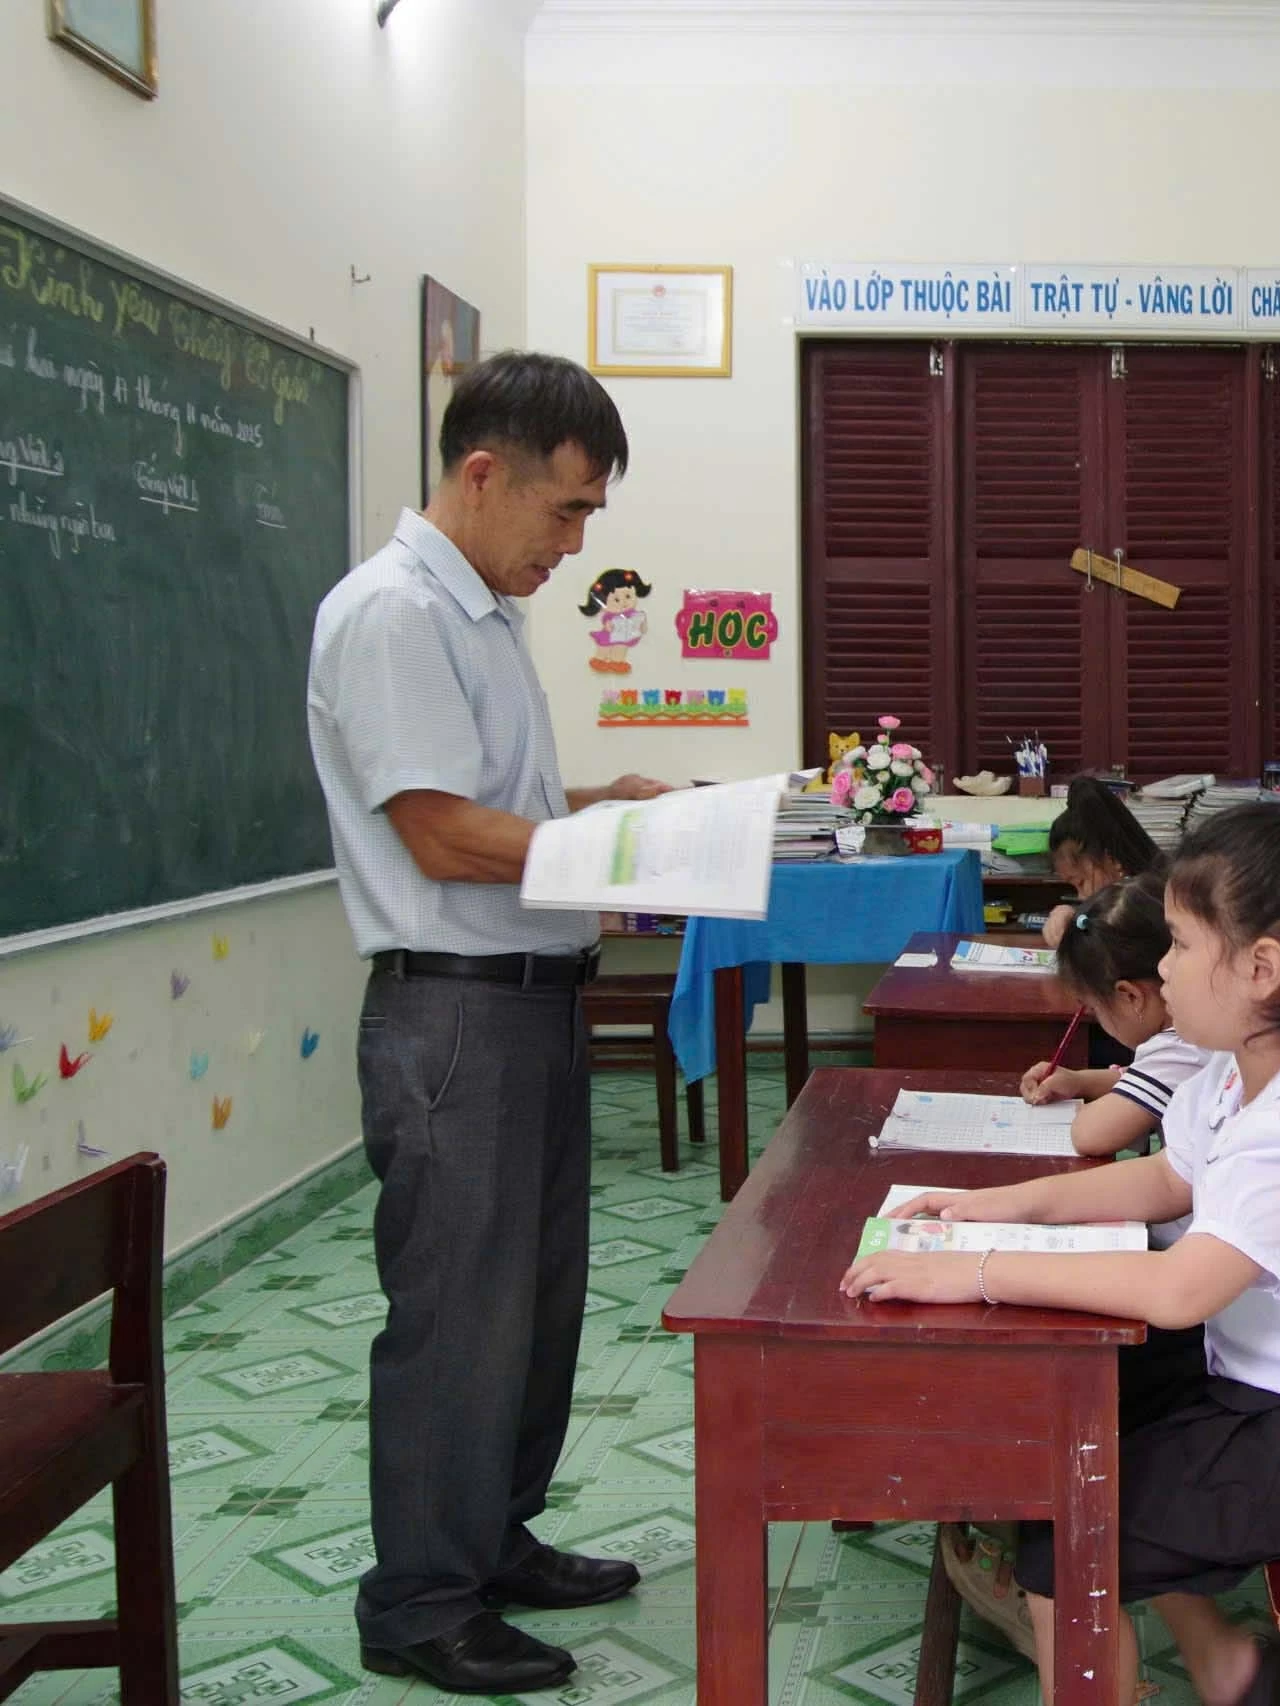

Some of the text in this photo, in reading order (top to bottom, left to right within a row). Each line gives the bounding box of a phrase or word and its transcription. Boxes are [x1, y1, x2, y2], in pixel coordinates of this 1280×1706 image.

[805, 270, 1011, 319] VÀO LỚP THUỘC BÀI
[1030, 274, 1084, 319] TRẬT
[1090, 277, 1120, 319] TỰ
[1138, 275, 1193, 315] VÂNG
[1199, 276, 1233, 315] LỜI
